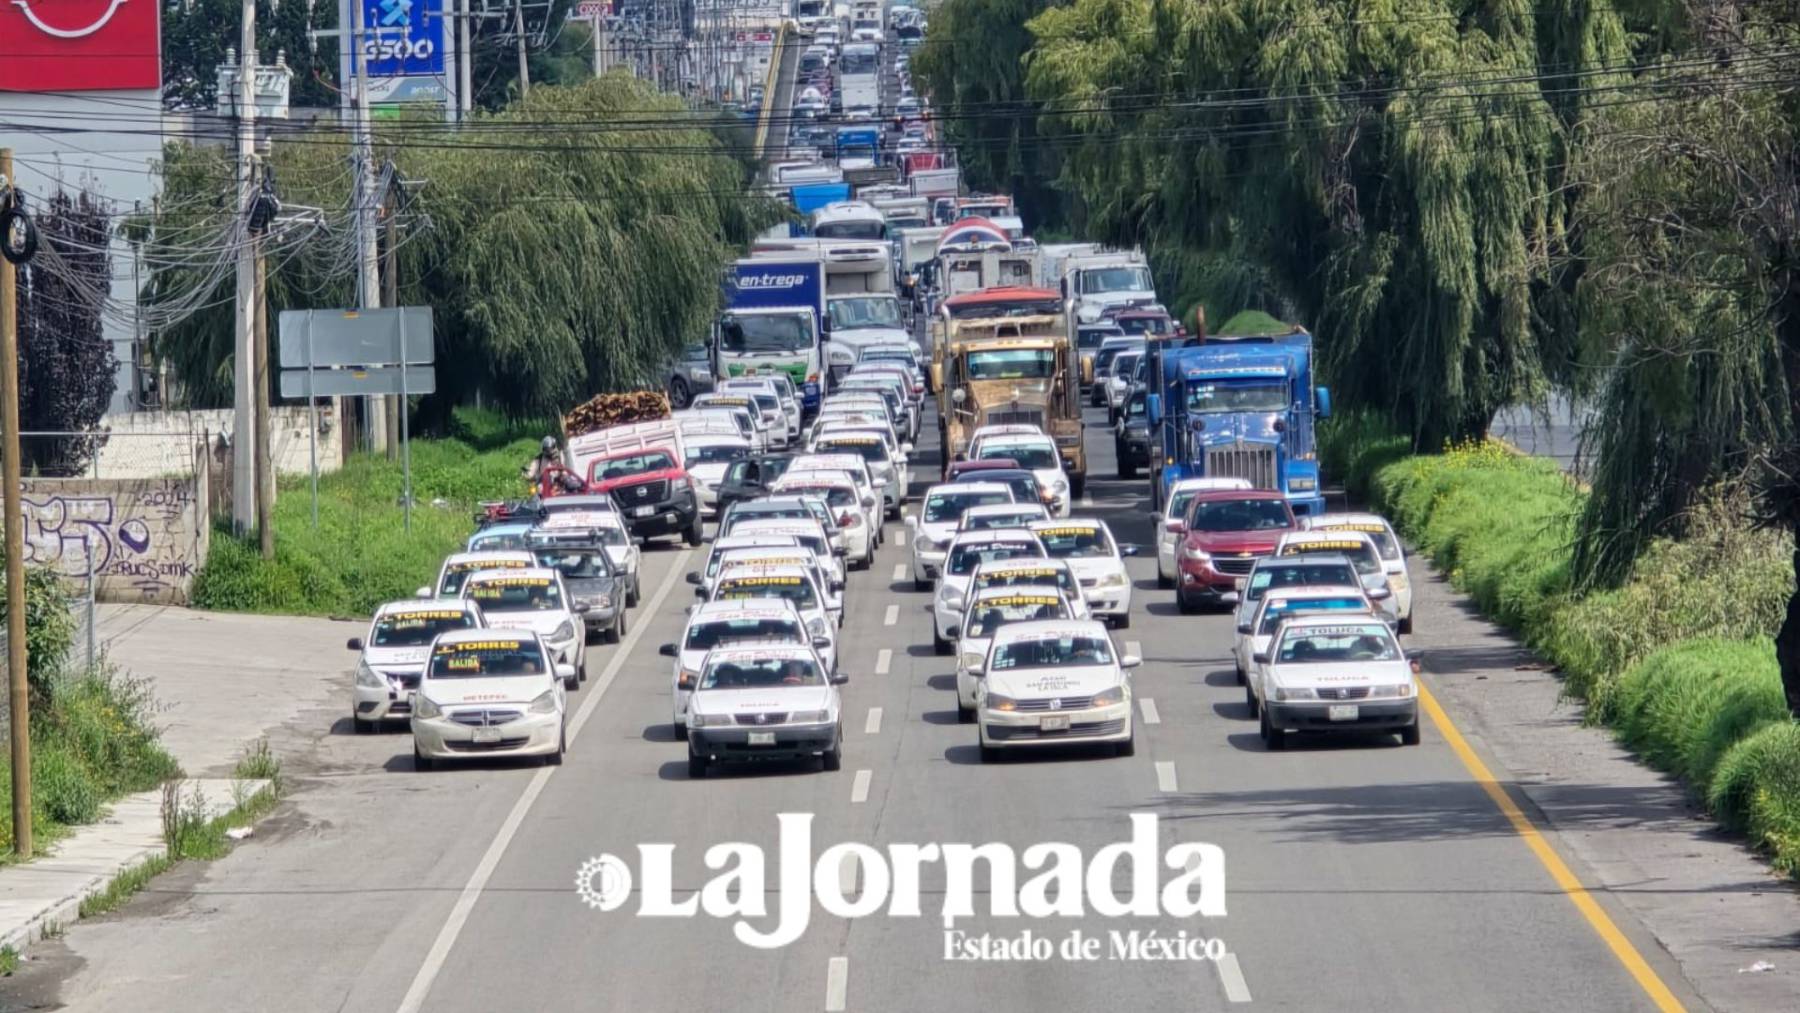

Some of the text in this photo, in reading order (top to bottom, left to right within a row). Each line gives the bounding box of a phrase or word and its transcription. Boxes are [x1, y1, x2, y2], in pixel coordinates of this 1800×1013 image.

[1298, 541, 1362, 551] TORRES
[484, 578, 550, 588] TORRES
[736, 577, 801, 586] TORRES
[991, 597, 1059, 607] TORRES
[394, 610, 463, 620] TORRES
[1310, 627, 1365, 636] TOLUCA
[455, 641, 520, 652] TORRES
